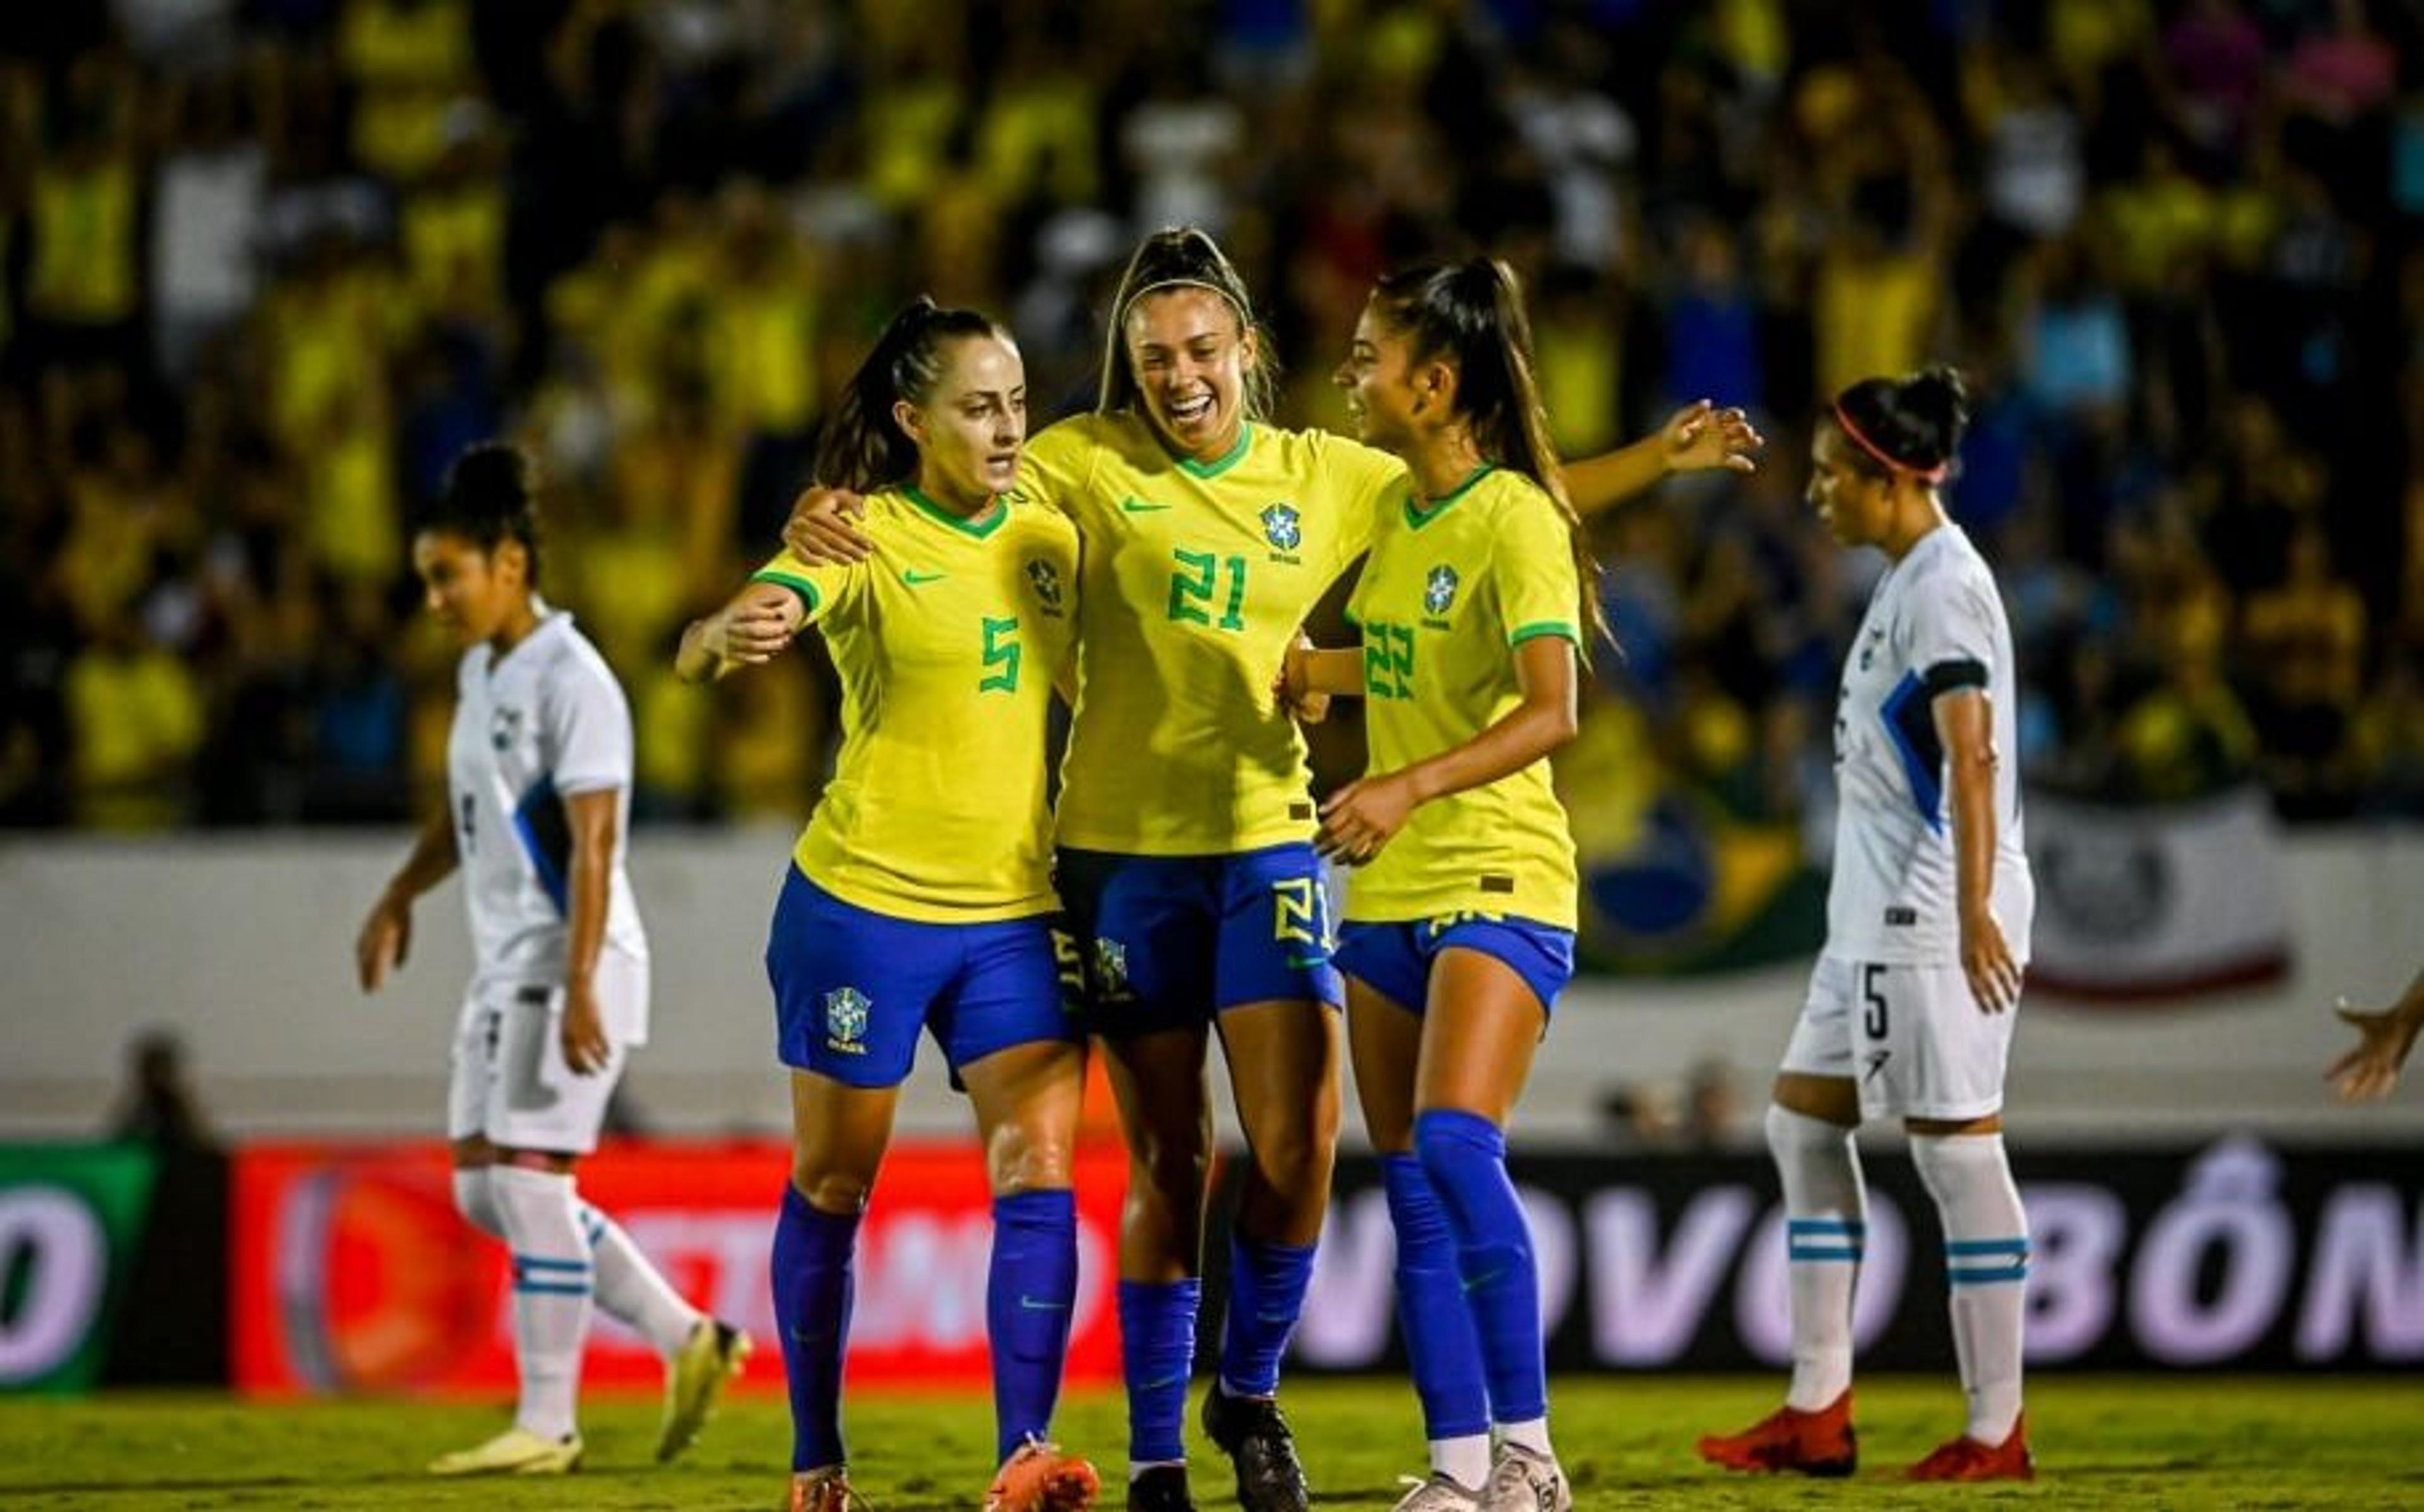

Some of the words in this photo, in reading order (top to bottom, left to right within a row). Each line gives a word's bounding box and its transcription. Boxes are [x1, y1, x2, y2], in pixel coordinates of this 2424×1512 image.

[1169, 549, 1245, 631] 21
[980, 617, 1020, 693] 5
[1366, 621, 1415, 700] 22
[1273, 877, 1336, 955] 21
[1864, 962, 1887, 1041] 5
